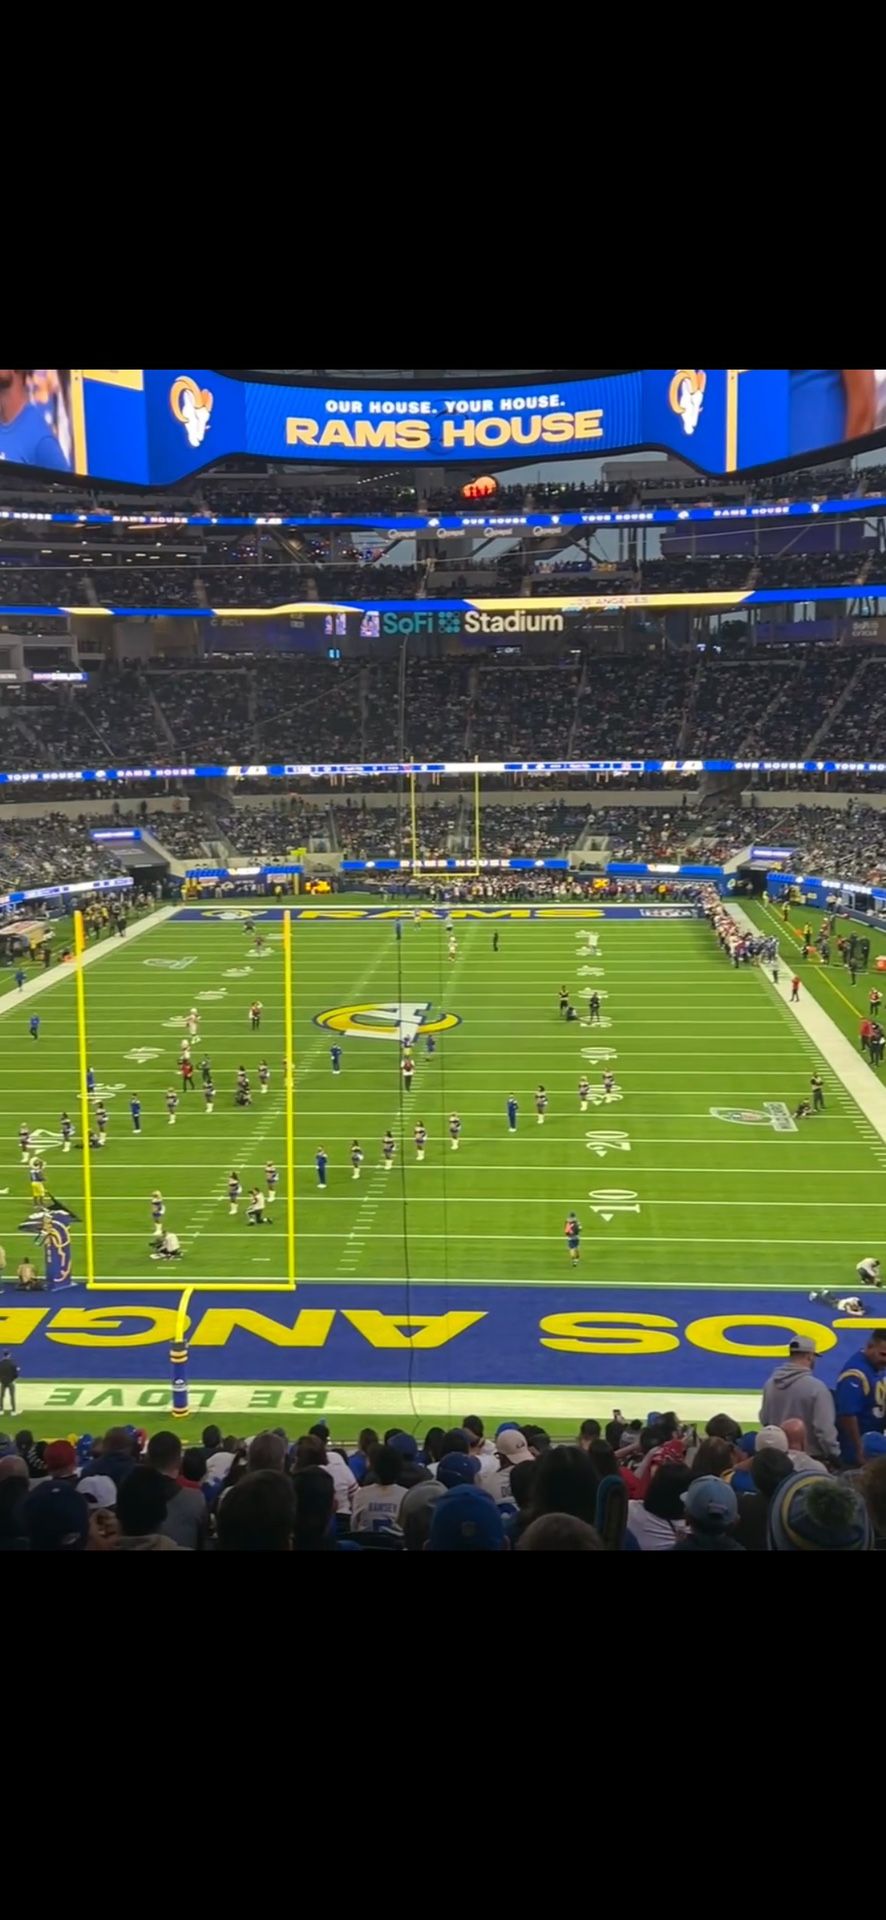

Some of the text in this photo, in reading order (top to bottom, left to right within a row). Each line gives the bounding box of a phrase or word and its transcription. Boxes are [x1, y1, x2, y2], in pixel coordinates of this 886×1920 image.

[325, 395, 566, 414] OUR HOUSE. YOUR HOUSE.
[285, 409, 604, 449] RAMS HOUSE
[383, 610, 564, 634] SoFi Stadium
[297, 909, 605, 919] RAMS
[585, 1130, 632, 1151] 20
[588, 1188, 640, 1213] 10
[44, 1386, 331, 1410] BE LOVE
